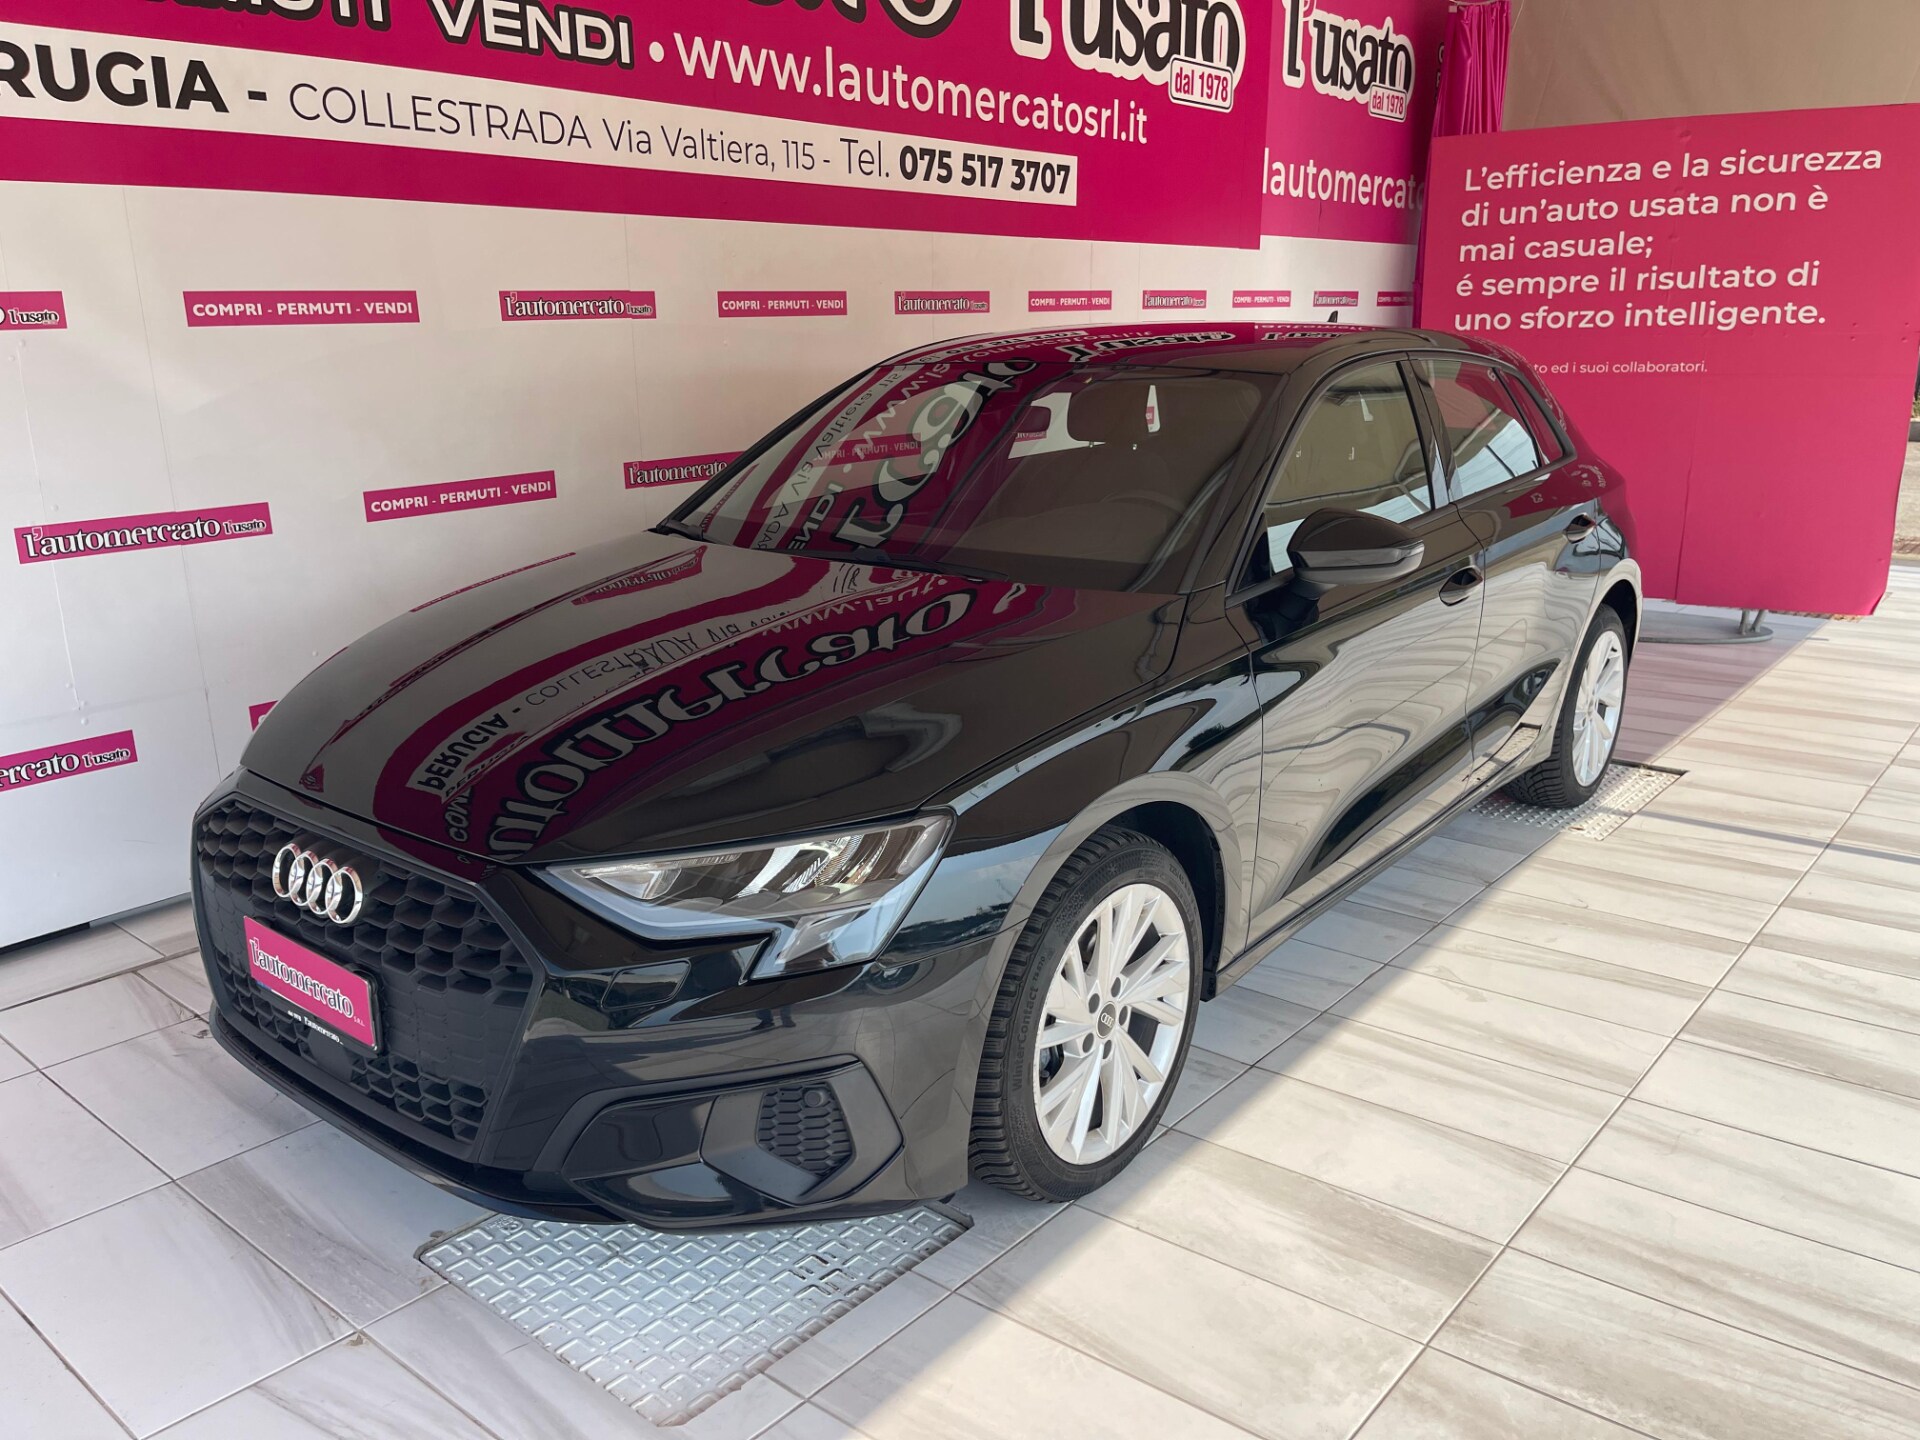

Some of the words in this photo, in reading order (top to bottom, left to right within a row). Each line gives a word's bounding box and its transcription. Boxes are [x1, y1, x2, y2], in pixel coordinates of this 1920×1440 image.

[430, 0, 632, 66] VENDI
[673, 32, 1148, 145] www.lautomercatosrl.it
[1174, 67, 1195, 96] dal
[1198, 71, 1229, 102] 1978
[1371, 91, 1384, 110] dal
[1386, 93, 1404, 116] 1978
[290, 83, 592, 149] COLLESTRADA
[602, 118, 652, 155] Via
[661, 125, 775, 171] Valtiera,
[782, 140, 815, 171] 115
[840, 138, 890, 178] Tel.
[900, 145, 952, 184] 075
[961, 153, 1003, 188] 517
[1010, 159, 1071, 194] 3707
[1465, 159, 1641, 192] L'efficienza
[1652, 160, 1672, 179] e
[1682, 153, 1709, 178] la
[1720, 148, 1882, 176] sicurezza
[1461, 202, 1489, 227] di
[1499, 198, 1618, 225] un'auto
[1629, 190, 1719, 218] usata
[1730, 191, 1797, 213] non
[1807, 184, 1829, 210] è
[1459, 236, 1515, 262] mai
[1524, 231, 1654, 260] casuale;
[1456, 274, 1474, 297] é
[1482, 271, 1600, 299] sempre
[1609, 266, 1627, 292] il
[1637, 263, 1777, 291] risultato
[1787, 260, 1821, 287] di
[192, 302, 264, 318] COMPRI
[277, 302, 352, 316] PERMUTI
[364, 302, 413, 315] VENDI
[505, 291, 625, 317] l'automercato
[722, 300, 761, 311] COMPRI
[768, 299, 810, 310] PERMUTI
[816, 299, 844, 310] VENDI
[898, 292, 970, 312] l'automercato
[1031, 298, 1056, 306] COMPRI
[1060, 298, 1088, 306] PERMUTI
[1091, 298, 1110, 306] VENDI
[1454, 309, 1512, 331] uno
[1520, 305, 1614, 330] sforzo
[1624, 299, 1826, 332] intelligente.
[1551, 361, 1569, 373] ed
[1572, 361, 1577, 373] i
[1579, 361, 1609, 373] suoi
[1612, 360, 1708, 374] collaboratori.
[629, 460, 727, 485] l'automercato
[370, 495, 429, 514] COMPRI
[439, 486, 502, 505] PERMUTI
[511, 480, 551, 497] VENDI
[249, 937, 354, 1018] l'automercato
